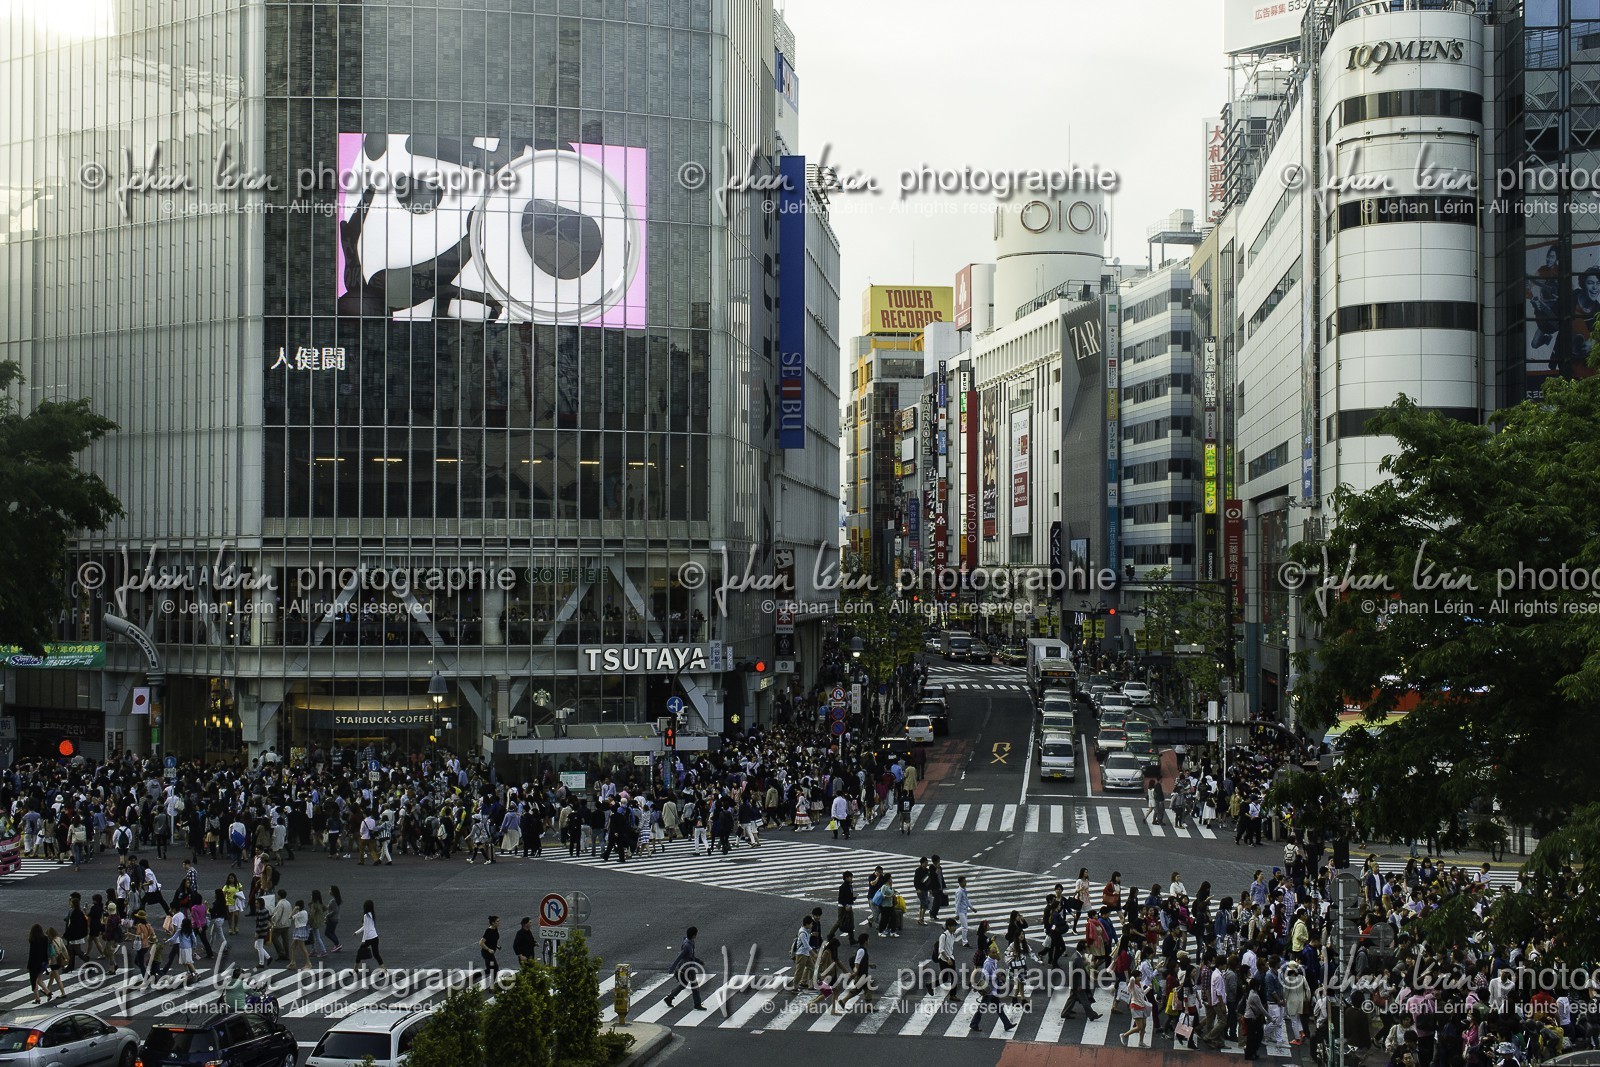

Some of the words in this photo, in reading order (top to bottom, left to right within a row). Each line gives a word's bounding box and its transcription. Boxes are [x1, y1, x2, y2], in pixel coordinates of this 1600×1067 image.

[1255, 4, 1286, 20] 広告募集
[1209, 125, 1225, 203] 大和証券
[886, 289, 934, 308] TOWER
[881, 310, 943, 328] RECORDS
[271, 346, 346, 371] 人健闘
[782, 352, 802, 430] SEIBU
[921, 394, 932, 456] KARAOKE
[1052, 528, 1061, 565] ZARA
[523, 567, 609, 584] COFFEE
[585, 647, 707, 671] TSUTAYA
[335, 716, 397, 724] STARBUCKS
[399, 714, 434, 723] COFFEE
[541, 928, 567, 939] ここから
